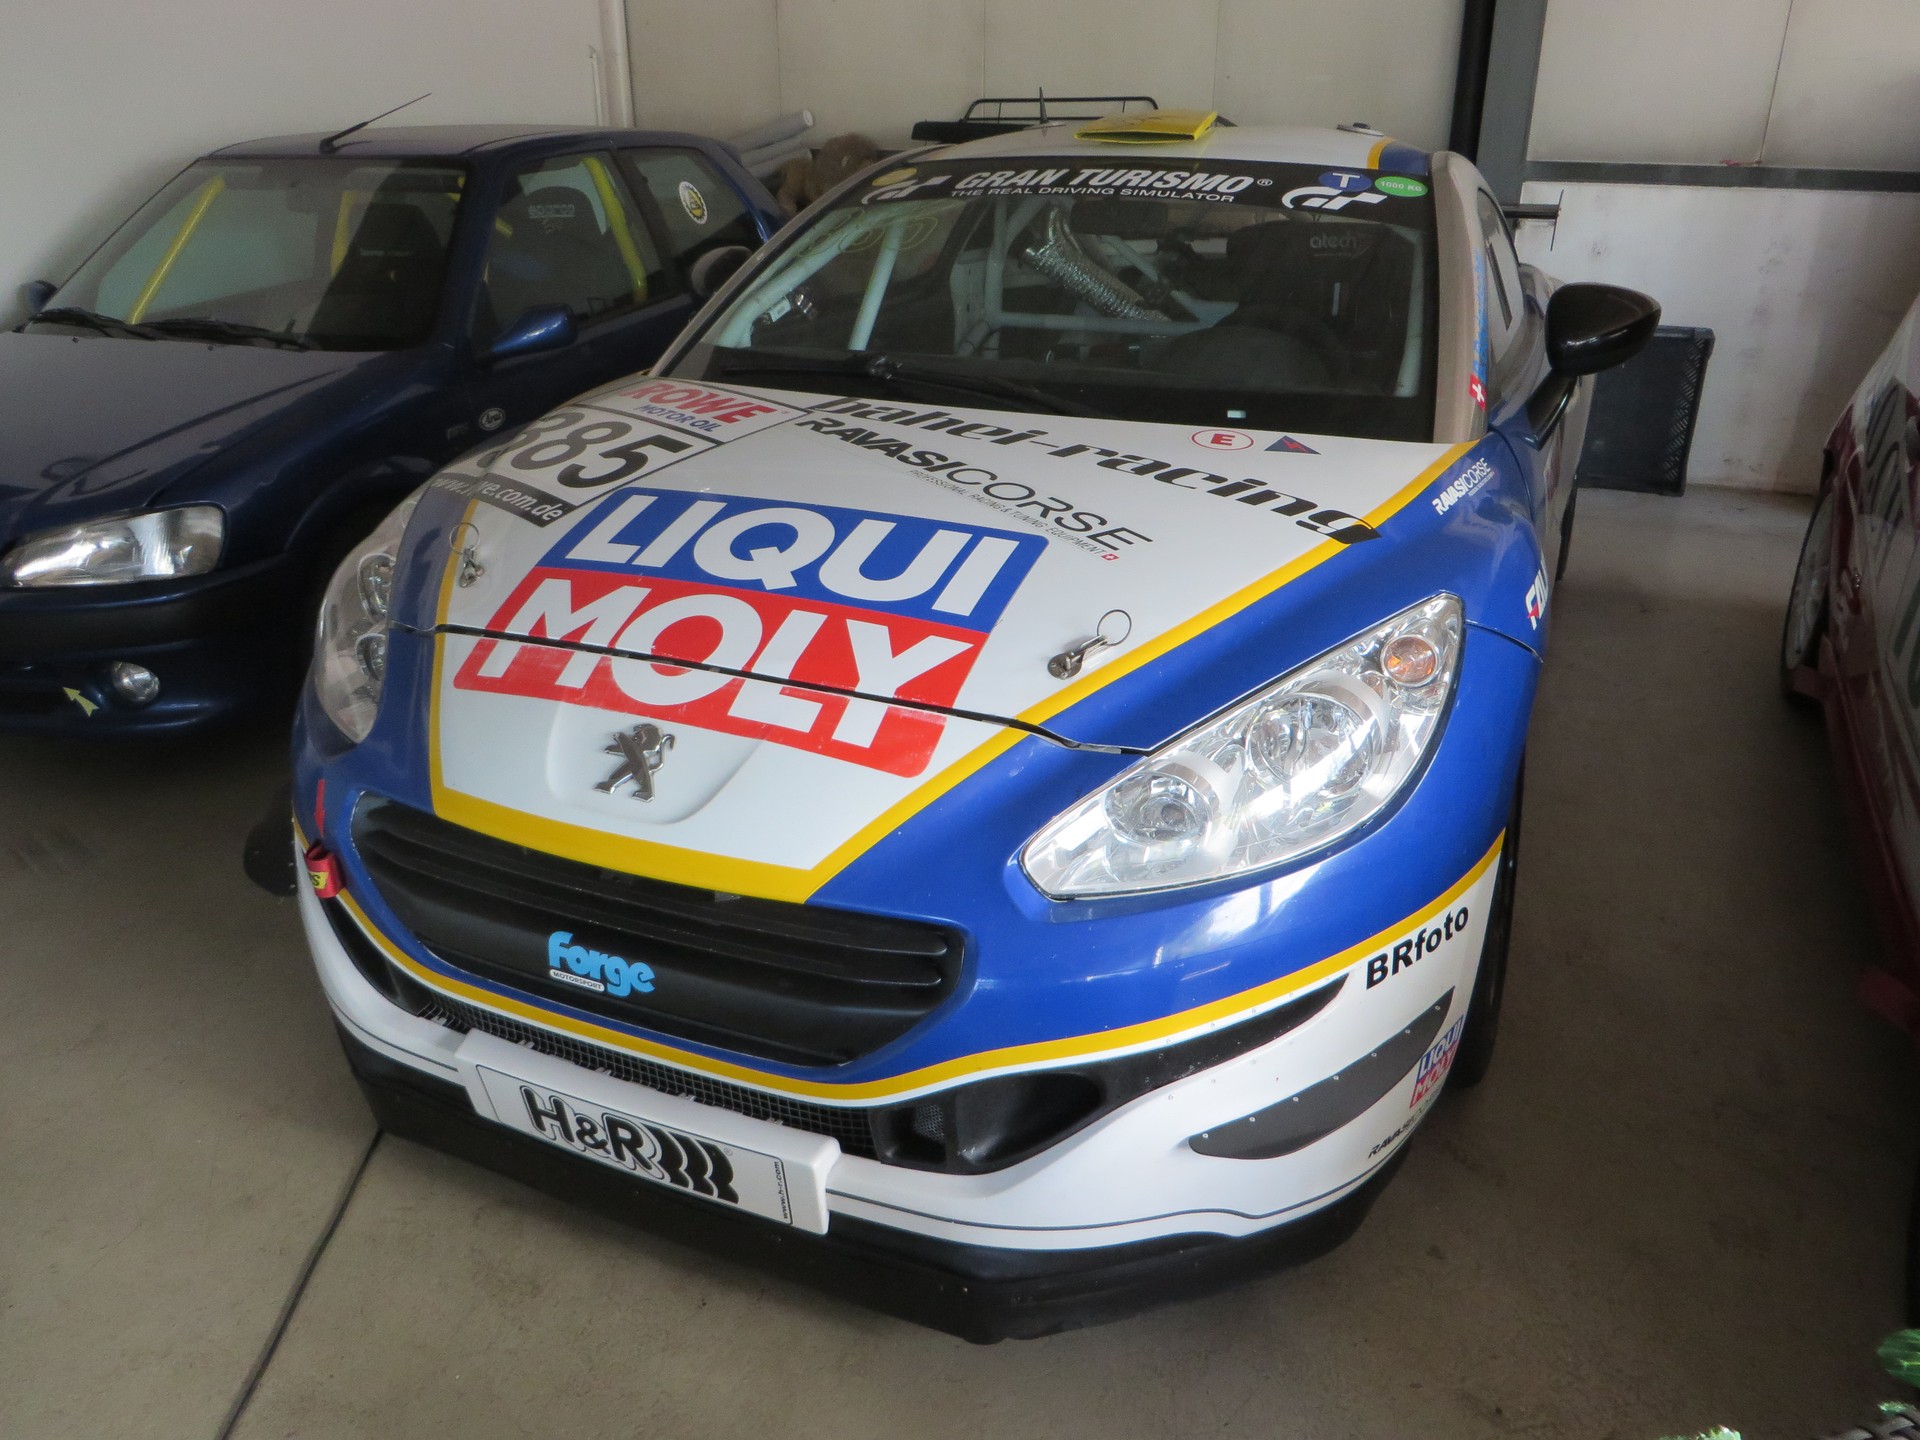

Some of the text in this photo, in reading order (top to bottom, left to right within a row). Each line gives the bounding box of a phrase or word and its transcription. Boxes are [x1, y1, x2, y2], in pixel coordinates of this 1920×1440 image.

[955, 169, 1070, 189] GRAN
[1331, 173, 1360, 188] T
[1379, 180, 1424, 193] 1000 KG
[951, 187, 1235, 203] THE REAL DRIVING SIMULATOR
[618, 383, 777, 424] ROWE
[634, 404, 723, 432] MOTOR OIL
[1210, 433, 1236, 446] E
[564, 494, 1020, 617] LIQUI
[477, 577, 976, 749] MOLY
[1366, 906, 1469, 990] BRfoto
[552, 971, 603, 990] MOTORSPORT
[520, 1086, 664, 1178] H&R
